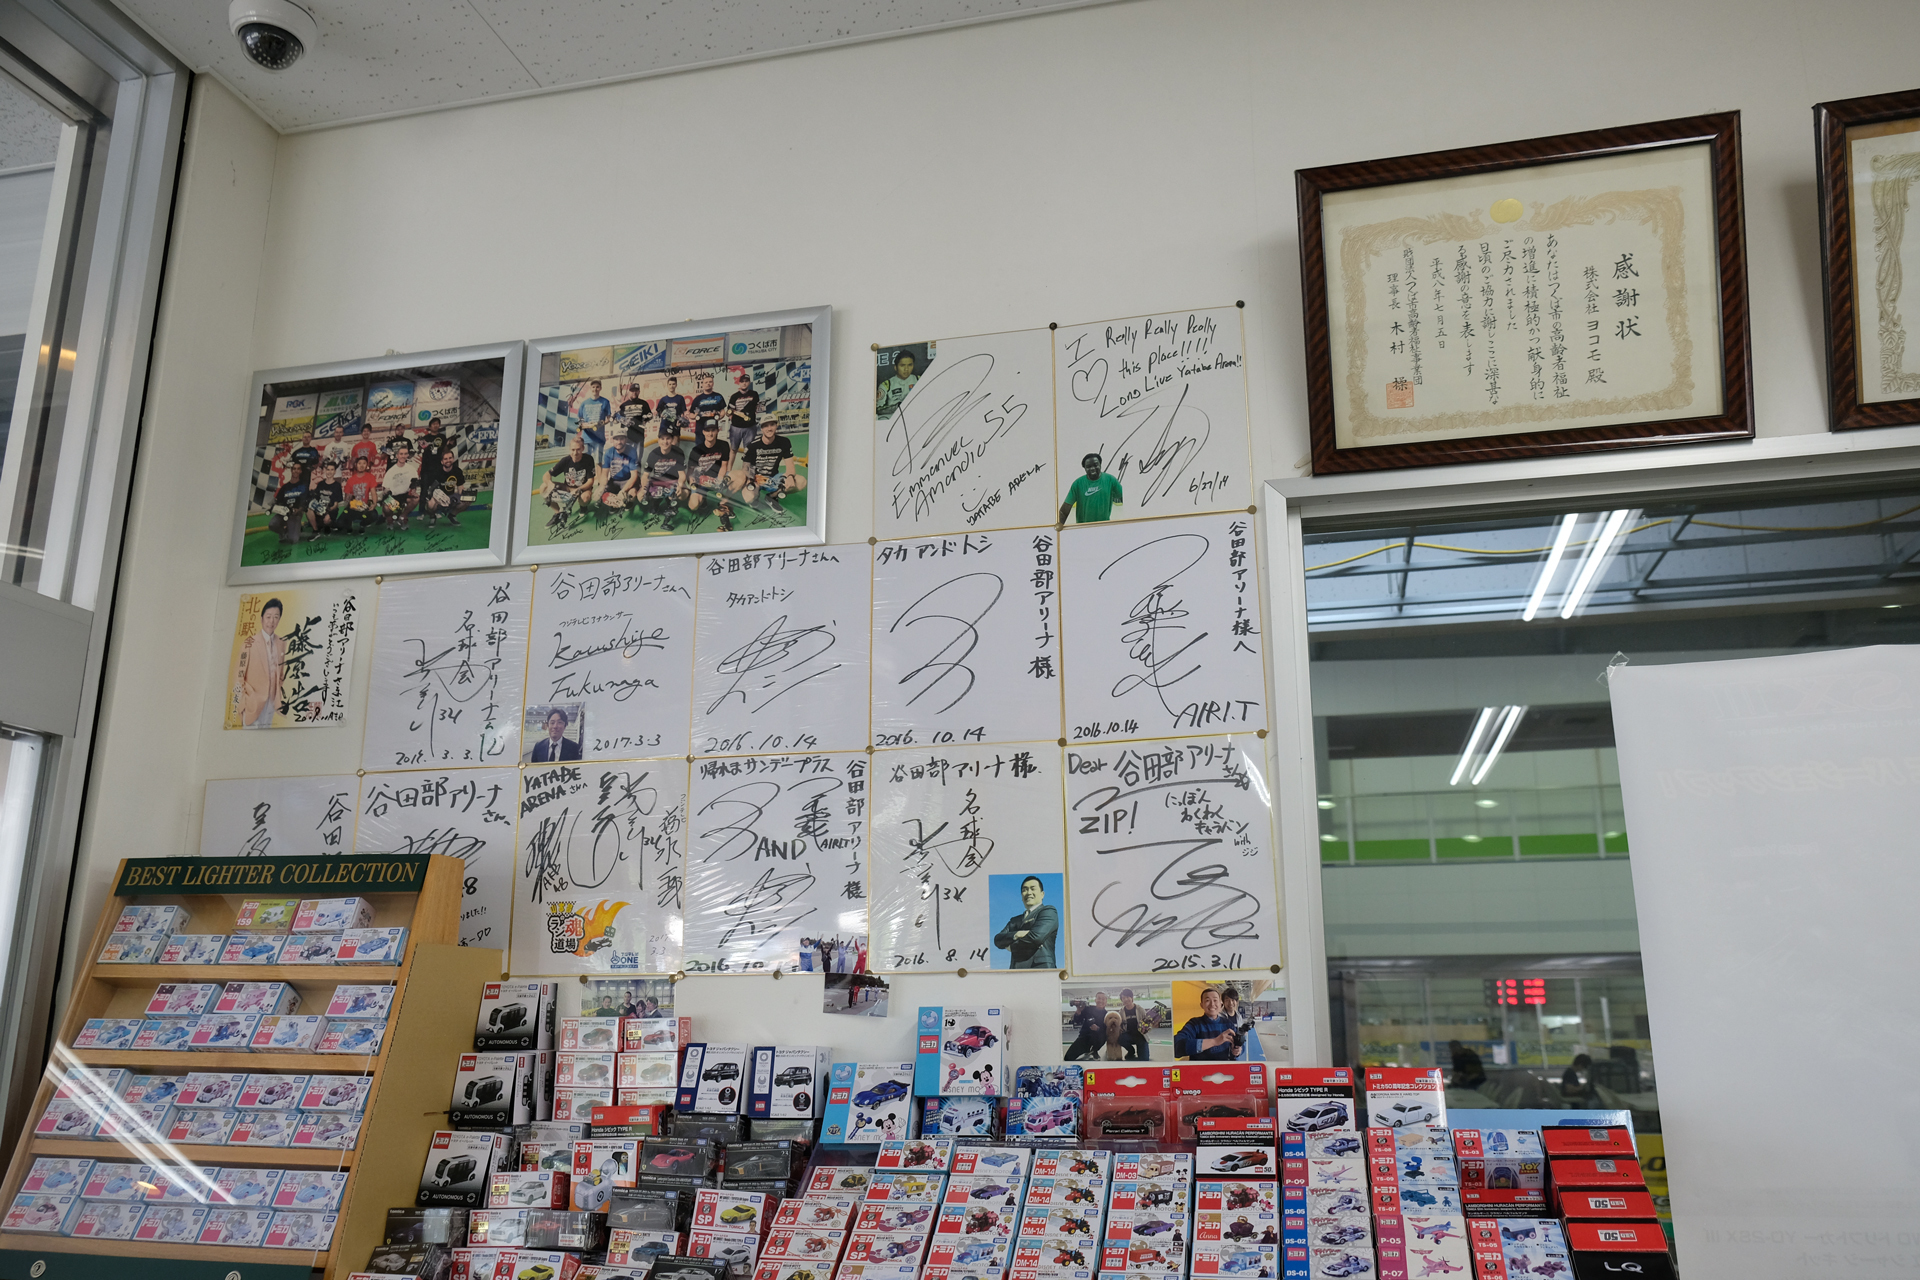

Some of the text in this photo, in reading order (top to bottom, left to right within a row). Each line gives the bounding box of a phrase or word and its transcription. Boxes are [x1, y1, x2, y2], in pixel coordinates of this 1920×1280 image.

[1500, 239, 1518, 331] ご尽力されました
[1612, 252, 1642, 341] 感謝状
[1430, 257, 1447, 349] 平成八年七月五日
[747, 339, 778, 350] つくば市
[1119, 358, 1141, 379] this
[1068, 753, 1107, 775] Dear
[523, 766, 582, 793] YATABE
[520, 785, 566, 819] ARENA
[755, 836, 807, 862] AND
[125, 862, 420, 886] BEST LIGHTER COLLECTION
[236, 918, 252, 926] 159
[554, 938, 577, 950] 道場
[620, 956, 639, 964] ONE
[563, 1039, 576, 1048] SP
[558, 1075, 571, 1083] SP
[832, 1092, 848, 1100] トミカ
[556, 1110, 569, 1119] SP
[575, 1142, 591, 1153] トミカ
[1037, 1158, 1057, 1167] トミカ
[1116, 1162, 1138, 1171] トミカ
[1034, 1167, 1055, 1176] DM-14
[1116, 1172, 1137, 1180] DM-03
[813, 1182, 828, 1190] SP
[871, 1182, 892, 1190] トミカ
[432, 1193, 464, 1201] AUTONOMOUS
[492, 1196, 505, 1204] 60
[699, 1192, 717, 1203] トミカ
[1028, 1195, 1050, 1204] DM-14
[863, 1204, 884, 1213] トミカ
[698, 1215, 712, 1225] SP
[778, 1216, 794, 1225] SP
[860, 1220, 876, 1229] SP
[1110, 1221, 1132, 1230] トミカ
[1472, 1221, 1495, 1229] トミカ
[1022, 1226, 1044, 1235] DM-14
[472, 1233, 485, 1242] 60
[612, 1232, 631, 1242] トミカ
[853, 1234, 874, 1244] トミカ
[768, 1246, 784, 1255] SP
[1017, 1247, 1040, 1256] トミカ
[850, 1252, 867, 1261] SP
[1015, 1258, 1038, 1267] DM-14
